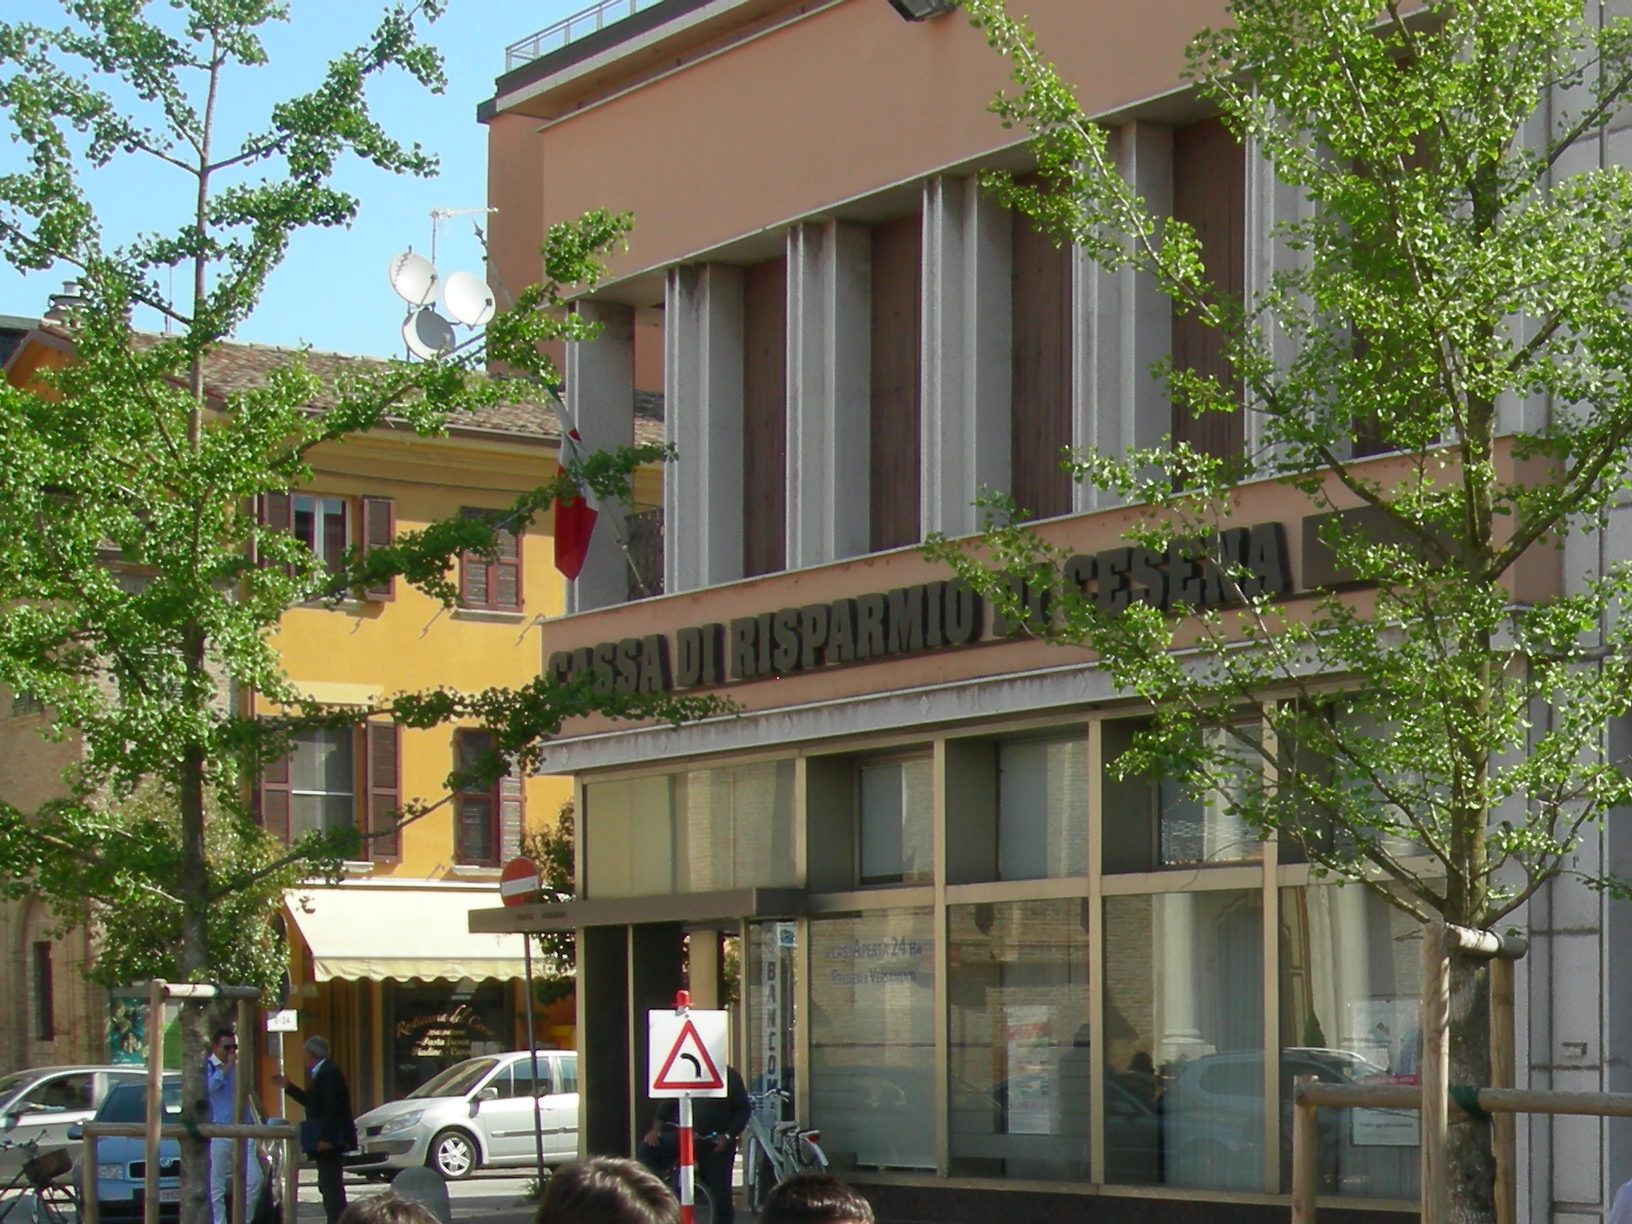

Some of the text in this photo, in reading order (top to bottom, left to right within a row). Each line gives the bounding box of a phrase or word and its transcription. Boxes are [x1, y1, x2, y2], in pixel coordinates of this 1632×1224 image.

[549, 521, 1292, 696] CASSA DI RISPARMIO DI CESENA
[766, 961, 778, 1145] BANCOM
